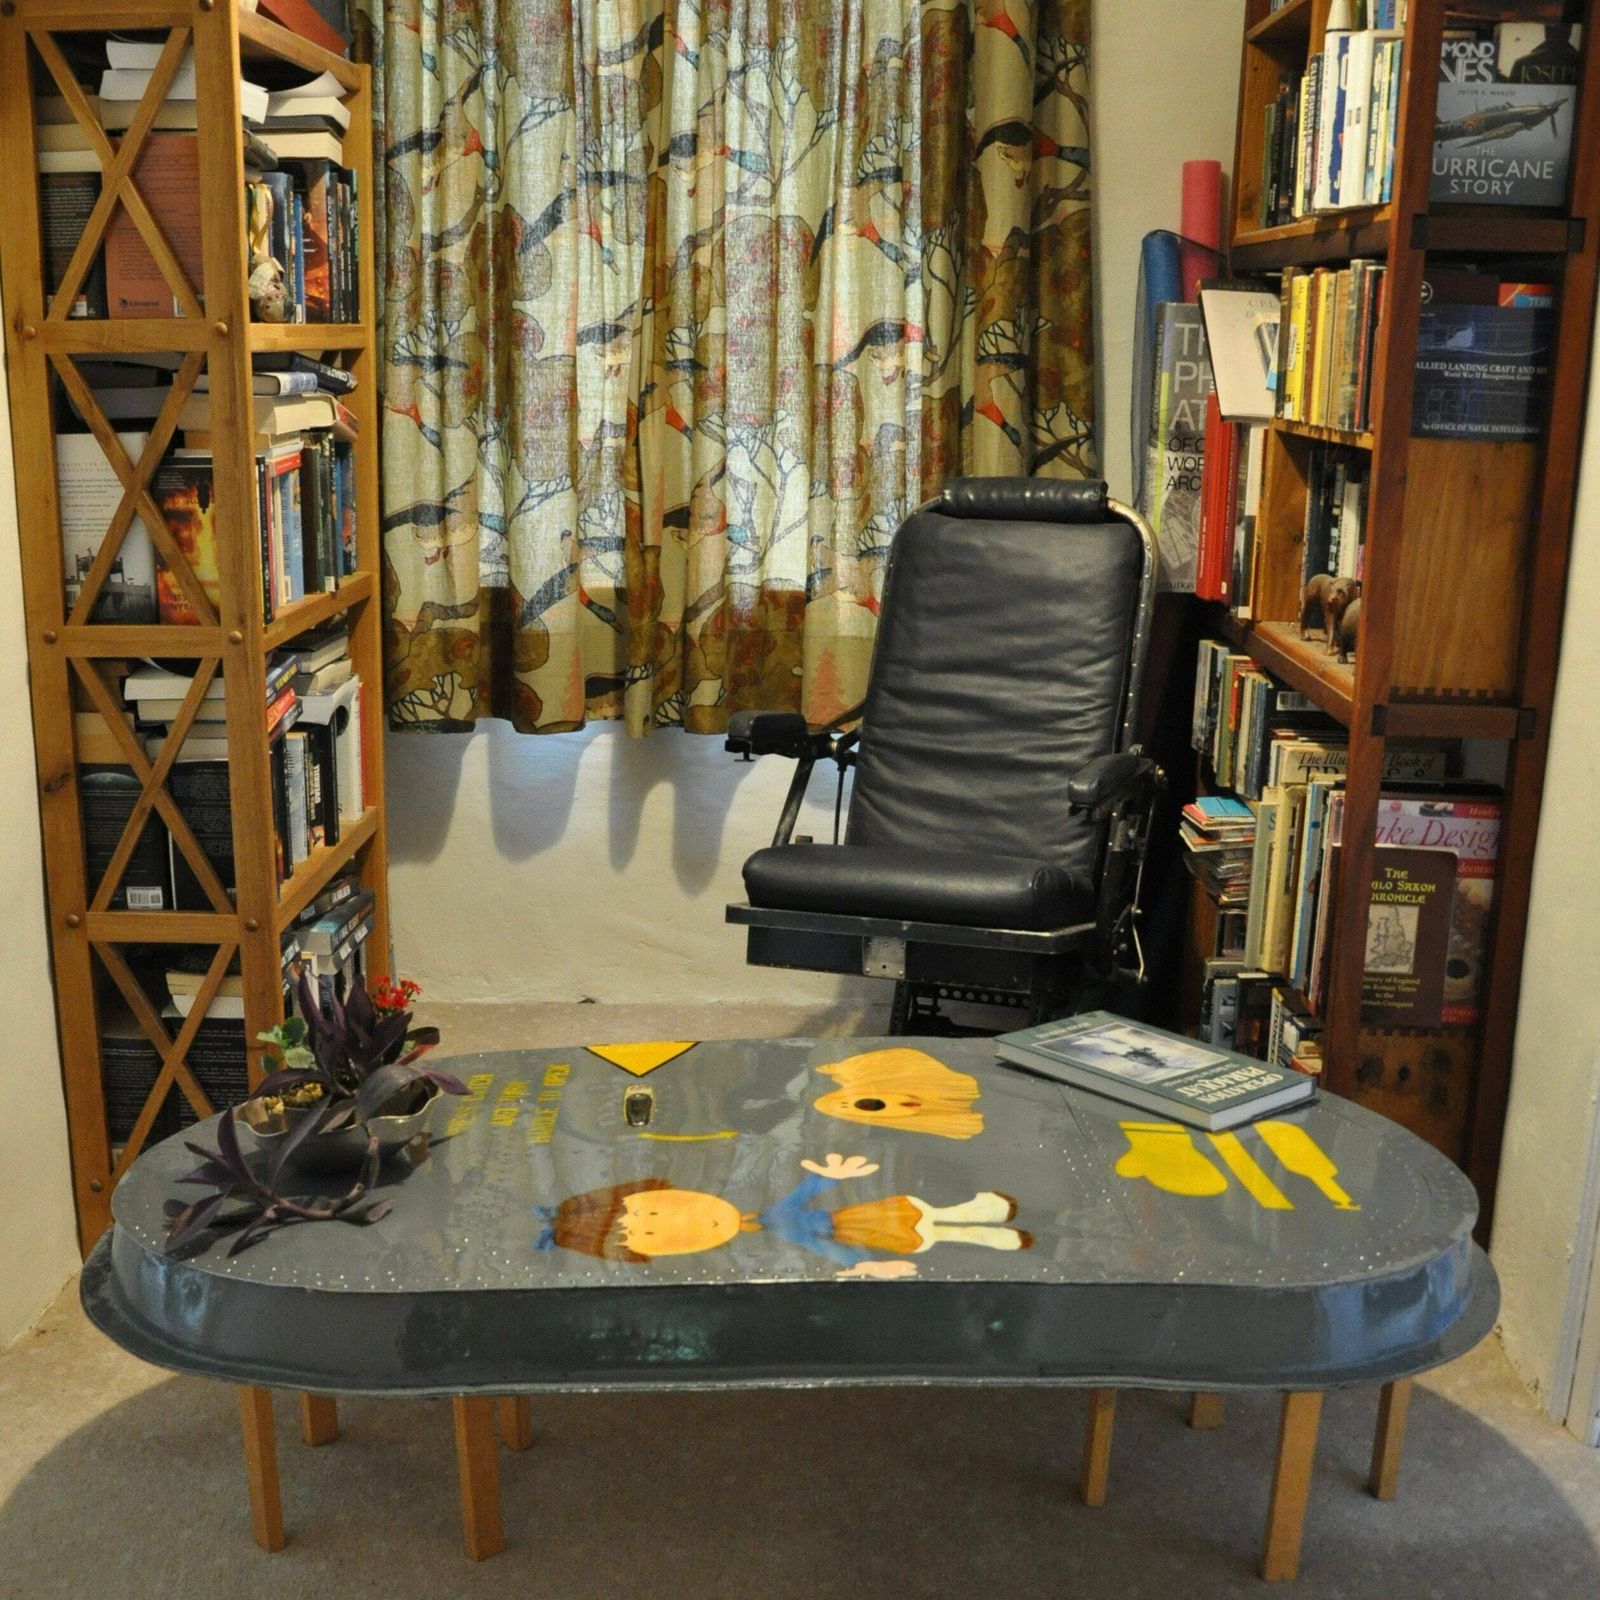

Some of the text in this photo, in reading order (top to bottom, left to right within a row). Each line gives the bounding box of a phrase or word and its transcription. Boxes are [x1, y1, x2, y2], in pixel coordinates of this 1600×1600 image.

[1441, 42, 1495, 58] MOND
[1308, 62, 1318, 93] CLIVE
[1306, 95, 1316, 143] CUSSLER
[1476, 146, 1497, 157] THE
[1432, 158, 1555, 179] URRICANE
[1450, 178, 1515, 195] STORY
[1174, 323, 1206, 355] TH
[1415, 361, 1447, 371] ALLIED
[1448, 362, 1488, 373] LANDING
[1489, 364, 1516, 374] CRAFT
[1518, 365, 1535, 375] AND
[1444, 370, 1462, 379] World
[1462, 371, 1474, 379] War
[1482, 372, 1515, 382] Recognition
[1431, 423, 1456, 431] OFFICE
[1457, 424, 1466, 432] OF
[1468, 424, 1489, 433] NAVAL
[1491, 425, 1540, 434] INTELLIGENC
[1168, 437, 1193, 453] OF
[1167, 456, 1205, 472] WOR
[1165, 475, 1202, 491] ARC
[1299, 751, 1324, 766] The
[1389, 753, 1421, 767] Book
[1422, 755, 1437, 770] of
[1376, 817, 1500, 857] ake Desig
[1384, 867, 1409, 880] THE
[1371, 880, 1436, 893] GLO SAXON
[1371, 893, 1426, 904] HRONICLE
[1196, 1073, 1284, 1104] OPERATION
